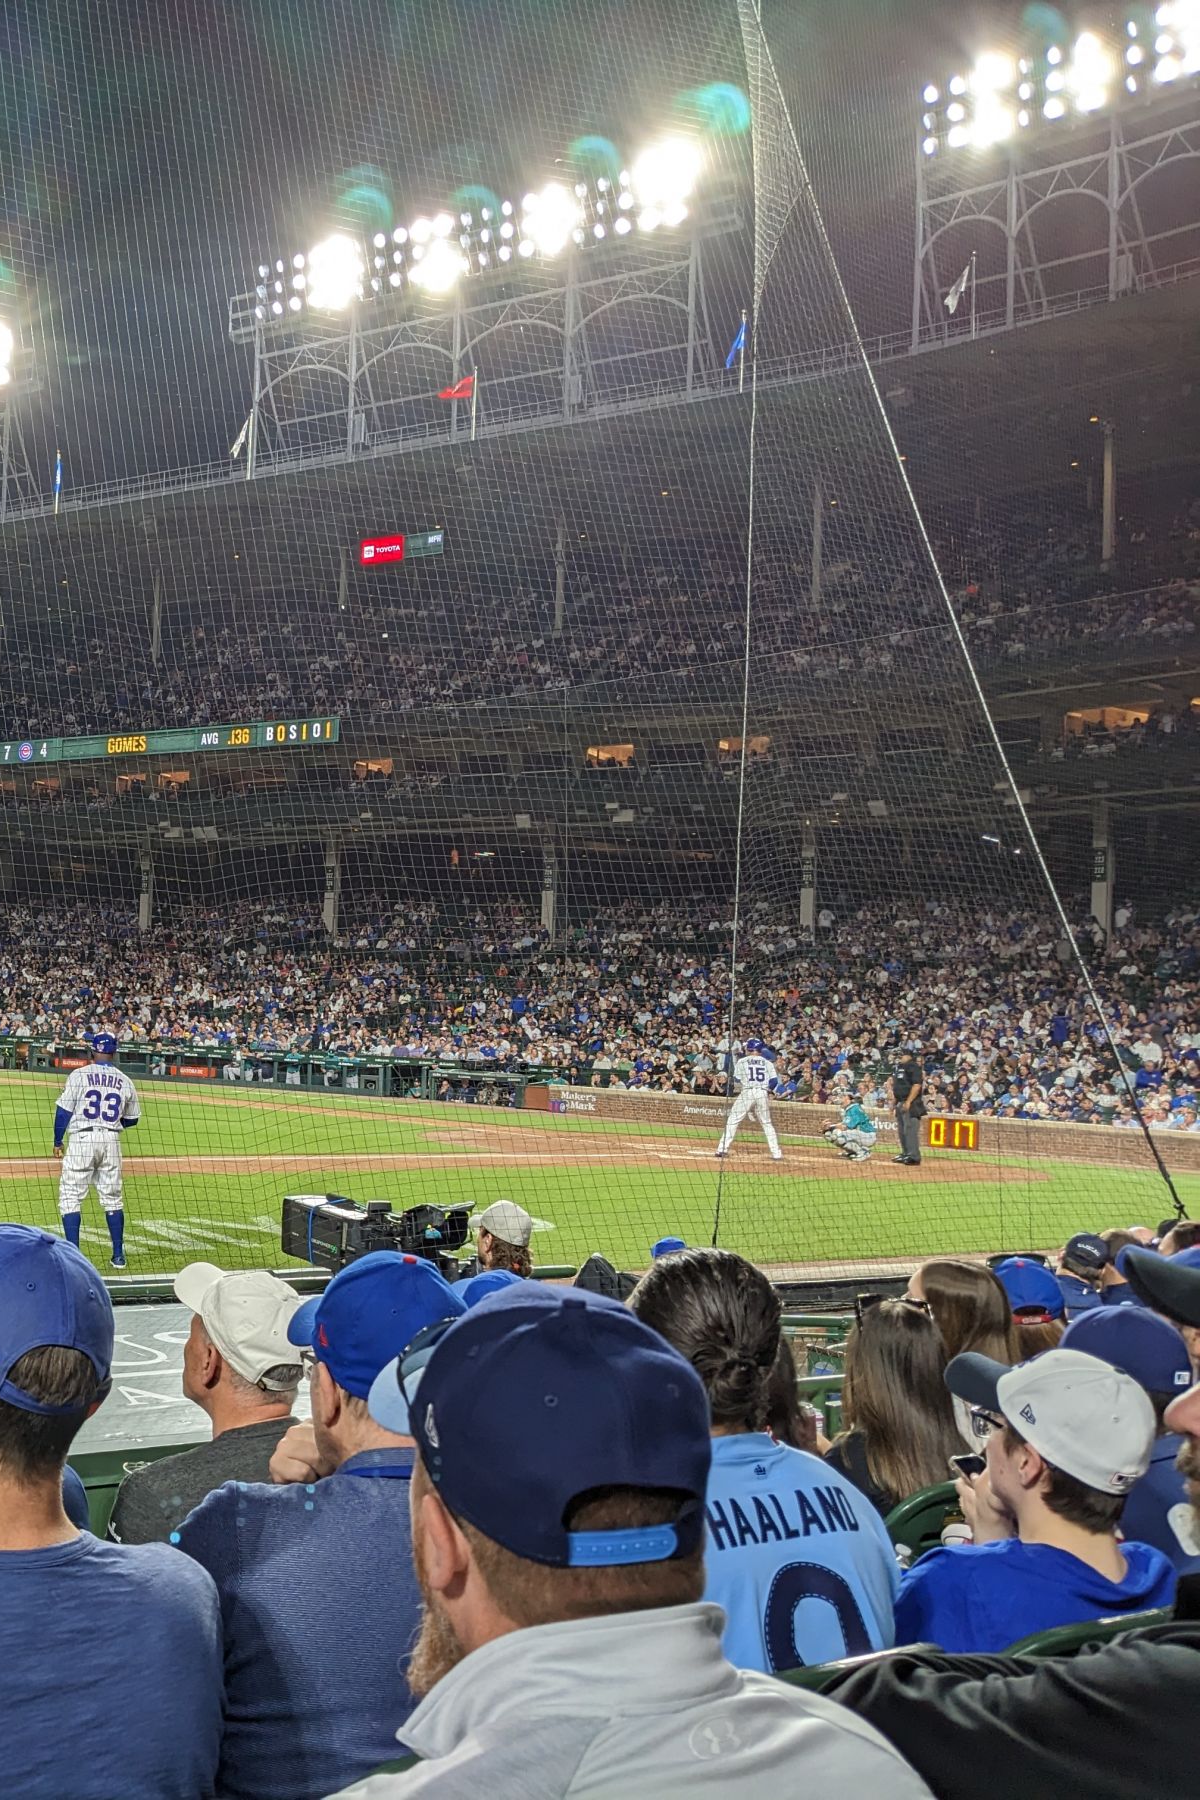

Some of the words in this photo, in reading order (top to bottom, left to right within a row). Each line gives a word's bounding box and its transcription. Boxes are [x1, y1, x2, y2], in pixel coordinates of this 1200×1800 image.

[376, 545, 400, 553] TOYOTA
[201, 733, 219, 745] AVG
[227, 729, 250, 745] .136
[266, 727, 274, 741] B
[289, 724, 297, 739] S
[302, 723, 307, 740] 1
[325, 721, 331, 738] 1
[4, 746, 11, 760] 7
[40, 743, 47, 757] 4
[108, 736, 146, 754] GOMES
[87, 1073, 123, 1090] HARRIS
[748, 1066, 765, 1082] 15
[561, 1091, 597, 1102] Maker's
[83, 1090, 122, 1123] 33
[570, 1101, 596, 1111] Mark
[683, 1106, 718, 1116] American
[704, 1486, 859, 1551] HAALAND
